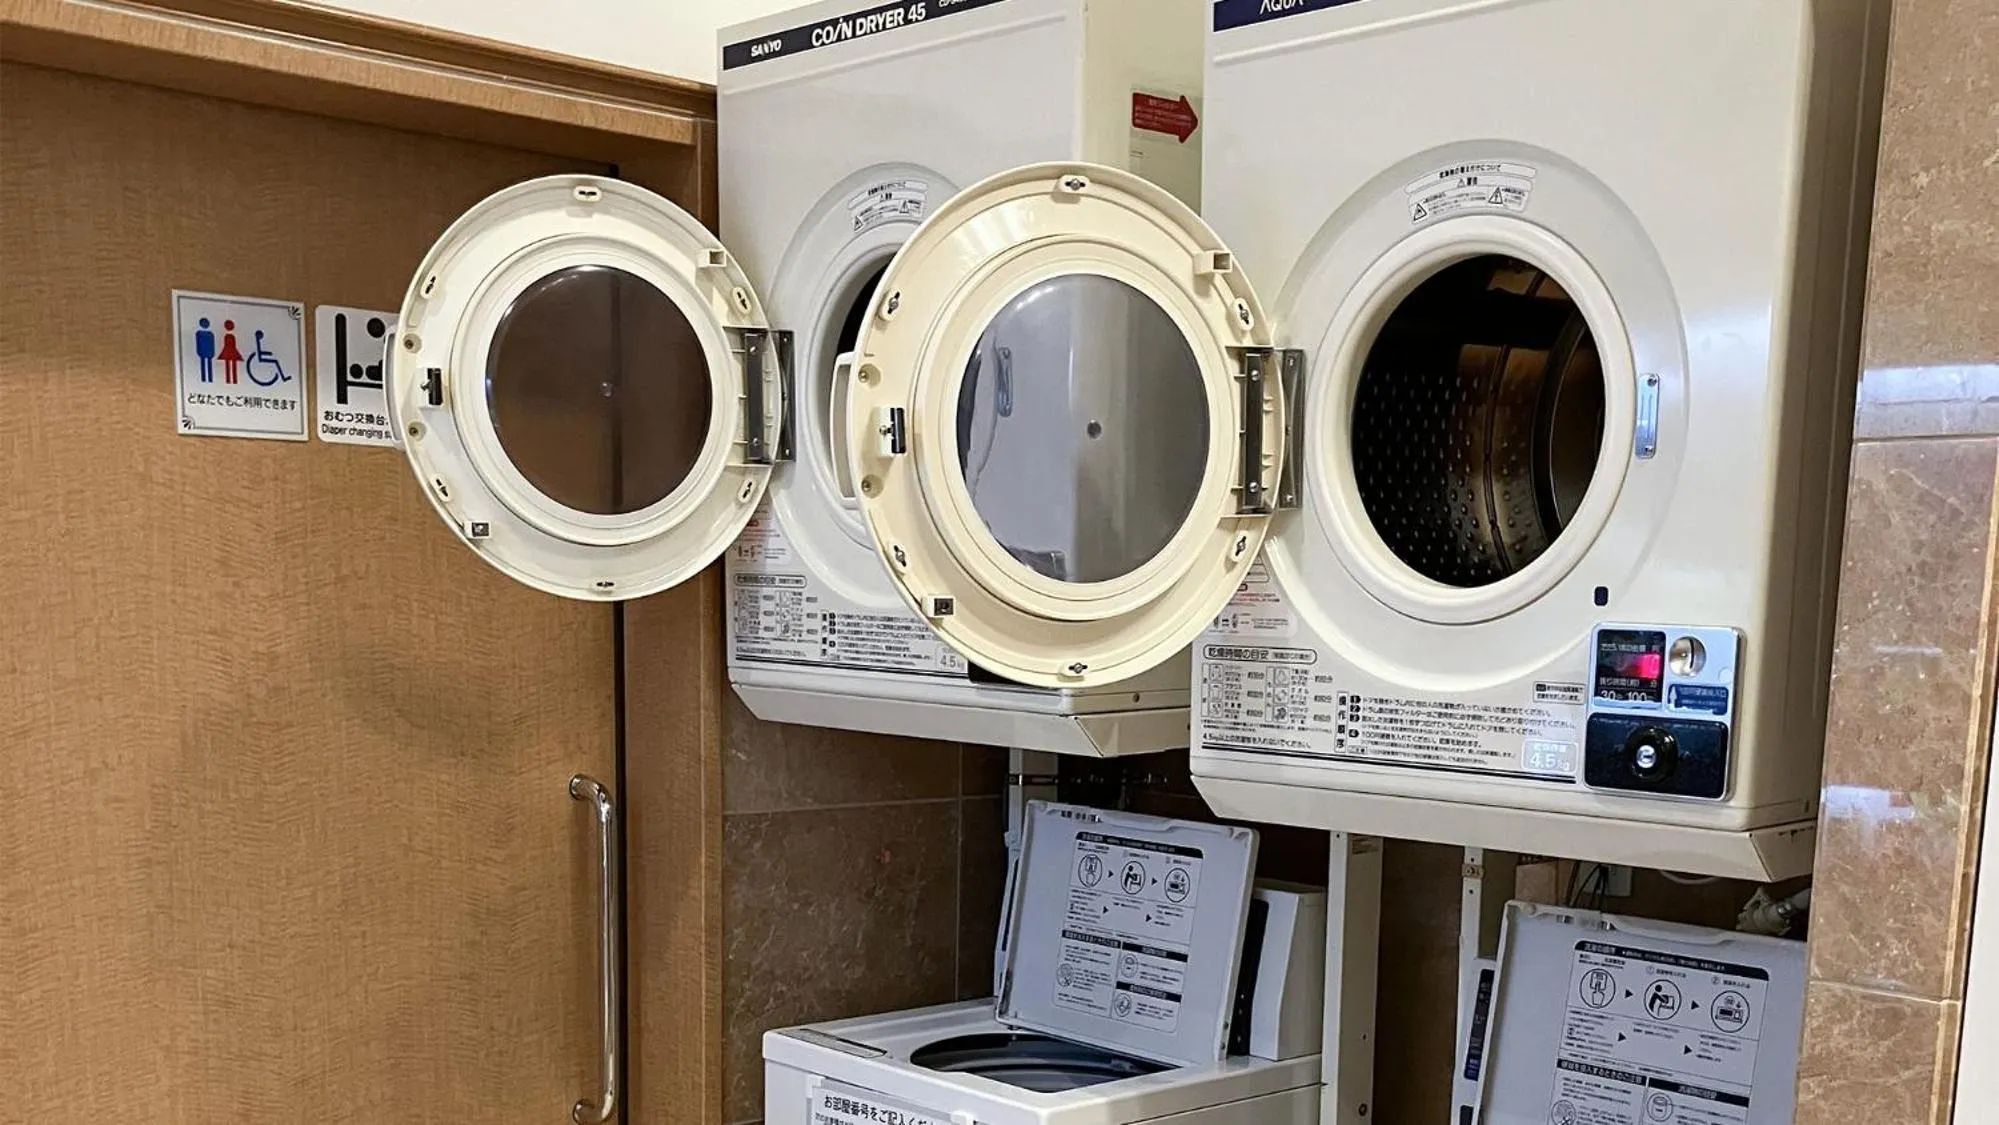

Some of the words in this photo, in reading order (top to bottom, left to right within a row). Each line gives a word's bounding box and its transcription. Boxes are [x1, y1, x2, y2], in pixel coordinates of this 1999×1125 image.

[751, 39, 782, 58] SANYO
[855, 8, 904, 37] DRYER
[907, 2, 927, 23] 45
[187, 393, 297, 412] どなたでもご利用できます
[323, 410, 389, 427] おむつ交換台
[321, 423, 348, 437] Diaper
[348, 426, 384, 440] changing
[1208, 647, 1269, 660] 乾燥時間の目安
[1530, 753, 1557, 770] 4.5
[824, 1095, 934, 1125] お部屋番号をご記入く
